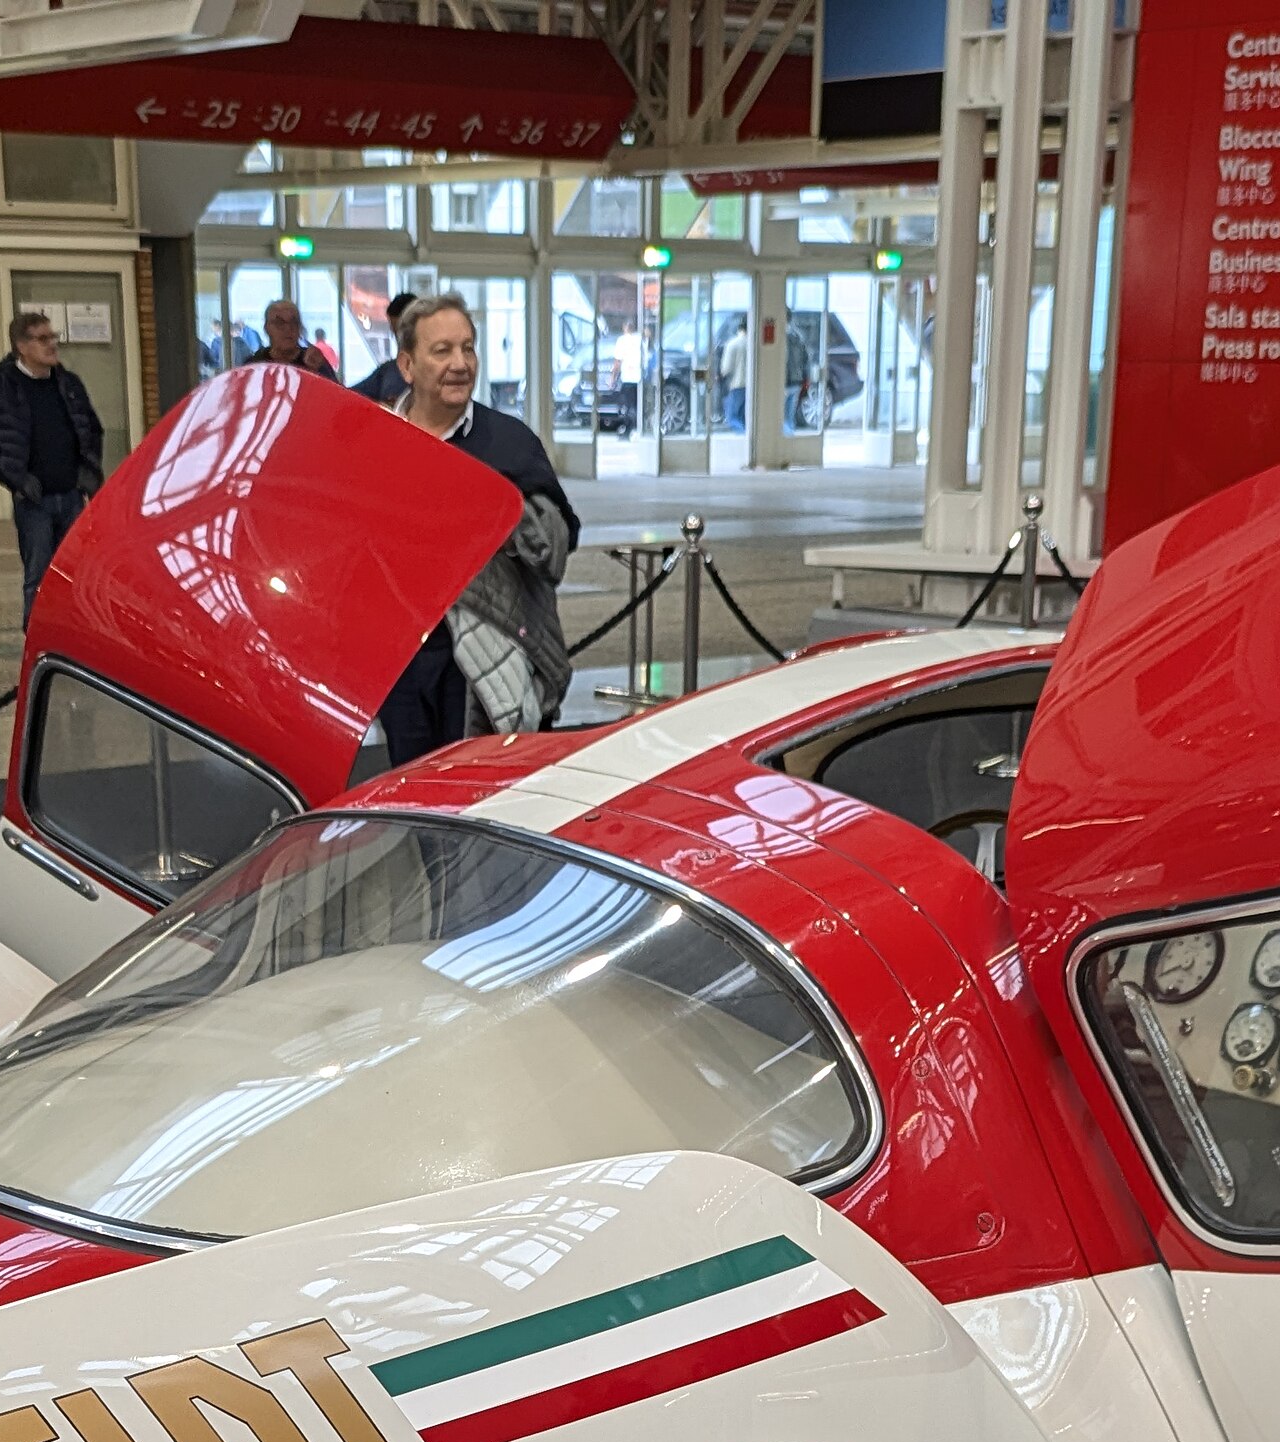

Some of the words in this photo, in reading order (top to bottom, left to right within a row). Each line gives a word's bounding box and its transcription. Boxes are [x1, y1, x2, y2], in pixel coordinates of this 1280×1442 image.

[201, 101, 241, 129] 25
[261, 104, 302, 133] 30
[344, 110, 381, 137] 44
[401, 113, 437, 139] 45
[510, 118, 547, 145] 36
[563, 122, 602, 148] 37
[1219, 156, 1273, 187] Wing
[1204, 302, 1248, 329] Sala
[1201, 332, 1256, 360] Press
